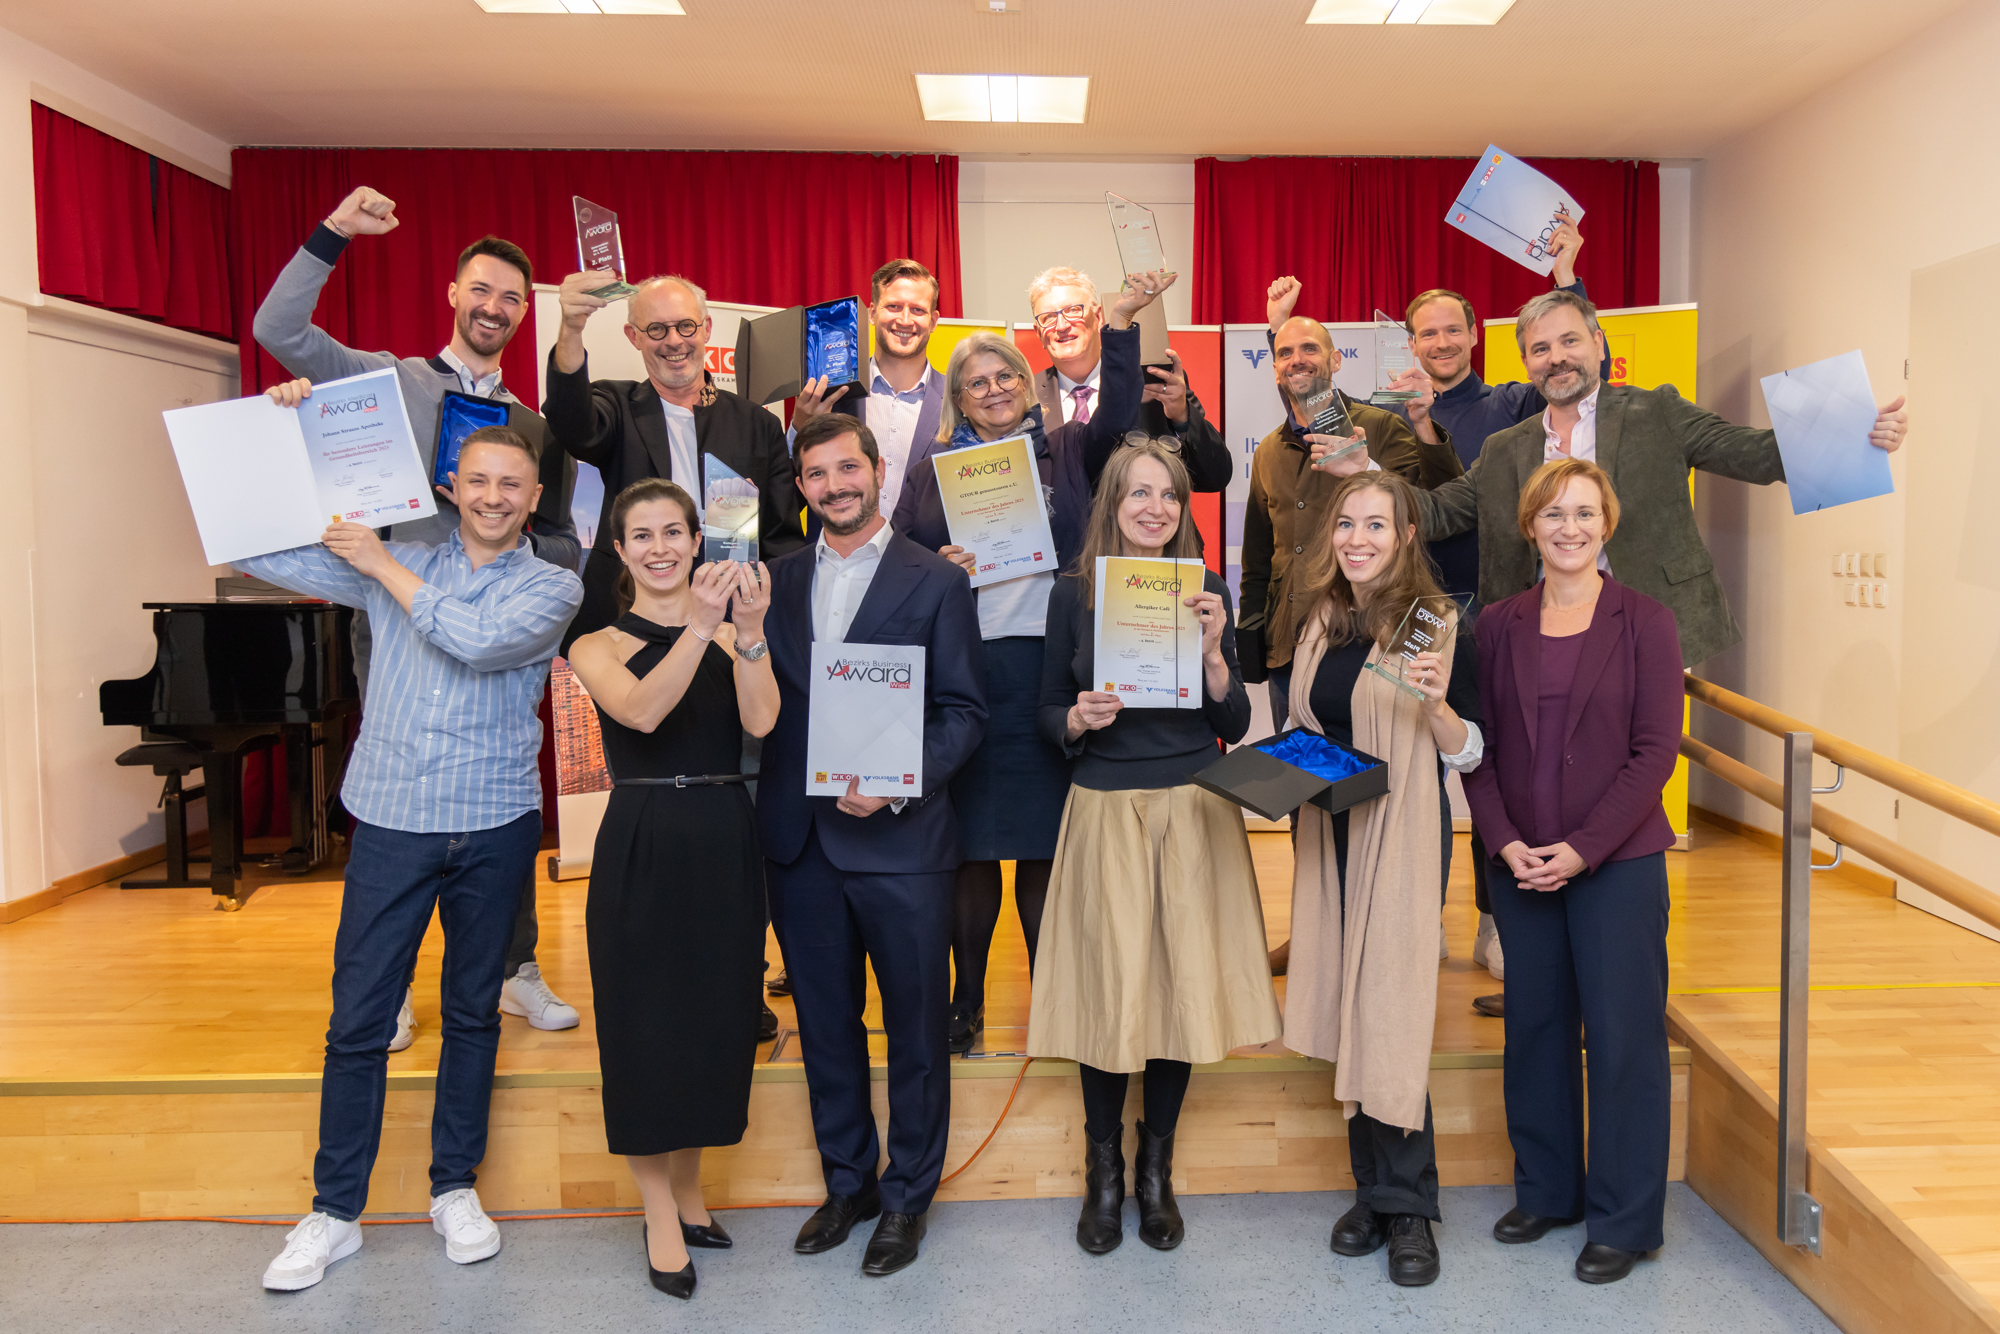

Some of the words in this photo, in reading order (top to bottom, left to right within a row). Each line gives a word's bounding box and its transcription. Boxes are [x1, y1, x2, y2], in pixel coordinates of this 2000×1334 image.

[1484, 166, 1495, 181] WKO
[585, 222, 612, 238] Award
[598, 255, 612, 263] Platz
[704, 350, 735, 371] KO
[320, 393, 378, 419] Award
[1306, 390, 1333, 407] Award
[331, 446, 356, 455] besondere
[357, 441, 385, 450] Leistungen
[960, 456, 1011, 480] Award
[713, 494, 750, 505] Award
[346, 511, 364, 519] WKO
[961, 505, 991, 516] Unternehmer
[1127, 574, 1182, 592] Award
[828, 659, 911, 683] Award
